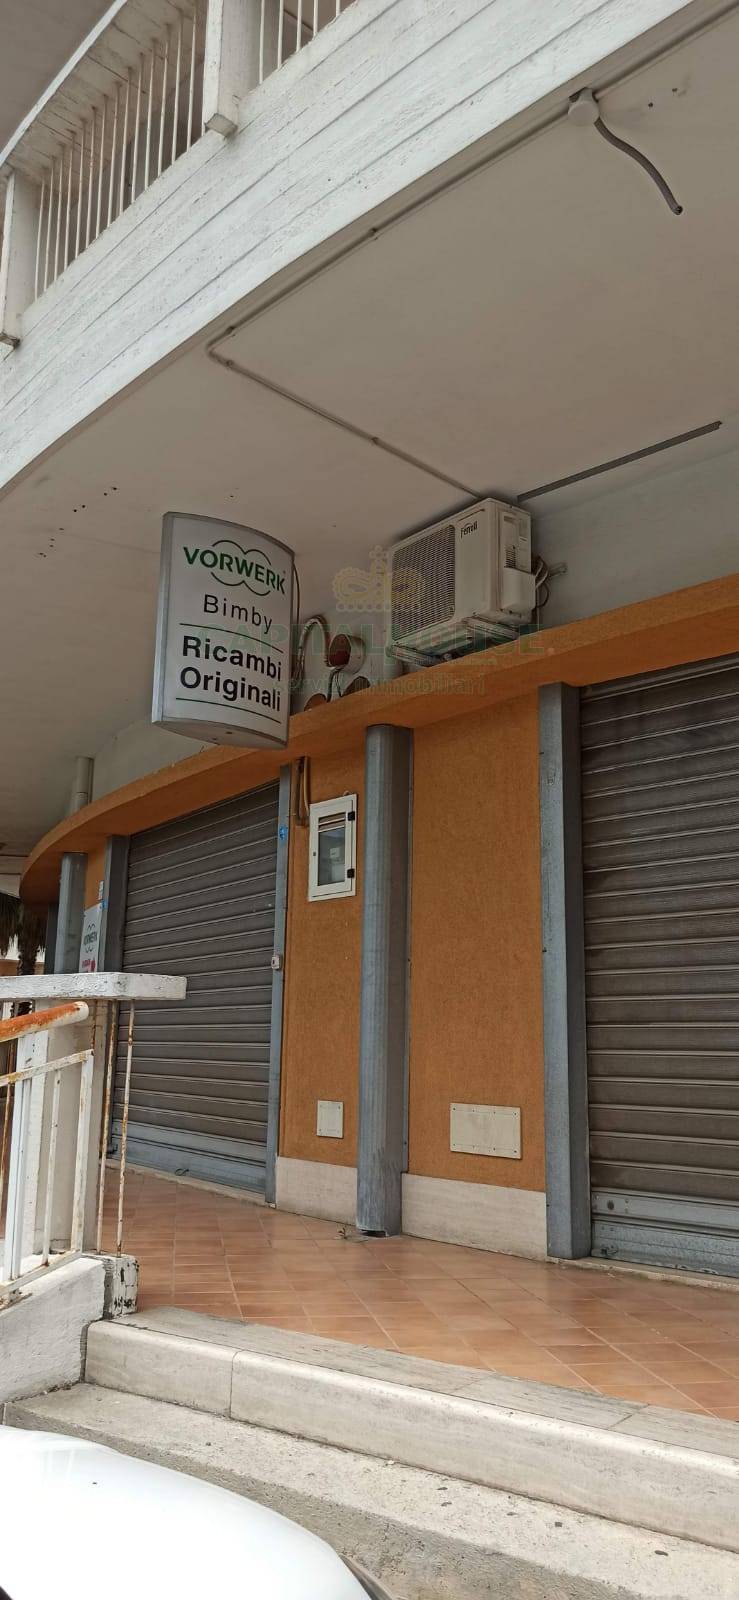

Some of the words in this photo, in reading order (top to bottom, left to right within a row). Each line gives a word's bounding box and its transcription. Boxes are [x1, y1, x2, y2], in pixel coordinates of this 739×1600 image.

[183, 546, 285, 596] VORWERK
[203, 594, 273, 634] Bimby
[182, 635, 282, 682] Ricambi
[180, 666, 281, 712] Originali
